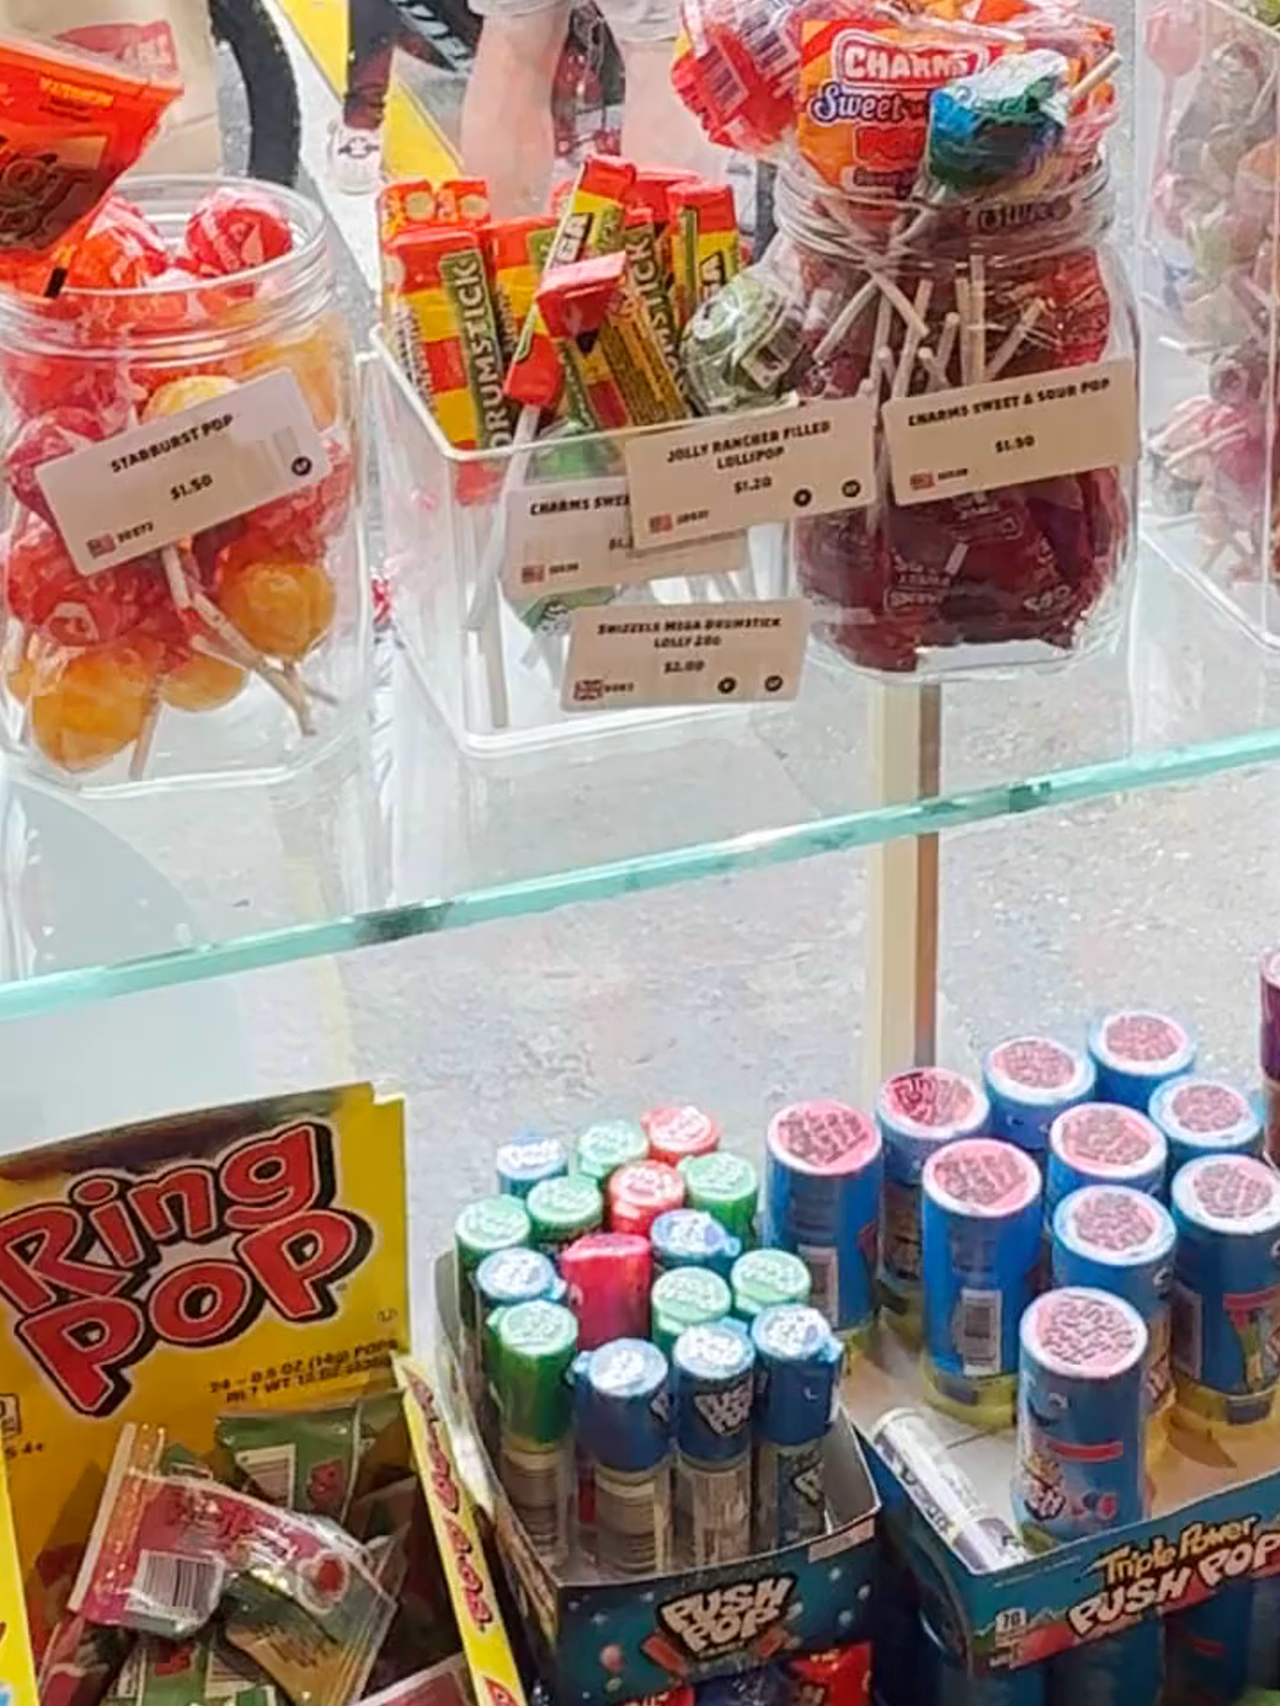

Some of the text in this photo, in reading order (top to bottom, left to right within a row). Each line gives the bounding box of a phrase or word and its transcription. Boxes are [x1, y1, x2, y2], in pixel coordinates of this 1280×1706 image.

[843, 47, 970, 78] CHARMS
[811, 83, 904, 124] Sweet
[455, 254, 515, 451] DRUMSTICK
[908, 405, 969, 427] CHARMS
[973, 394, 1020, 415] SWEET
[1037, 385, 1078, 403] SOUR
[1080, 378, 1110, 394] POP
[111, 413, 234, 473] STARBURST POP
[668, 420, 831, 463] JOLLY RANCHER FILLED
[717, 445, 785, 470] LOLLIPOP
[531, 496, 590, 516] CHARMS
[1098, 1535, 1176, 1584] Triple
[661, 1576, 796, 1632] PUSH
[1068, 1566, 1194, 1635] PUSH
[683, 1606, 780, 1654] POP
